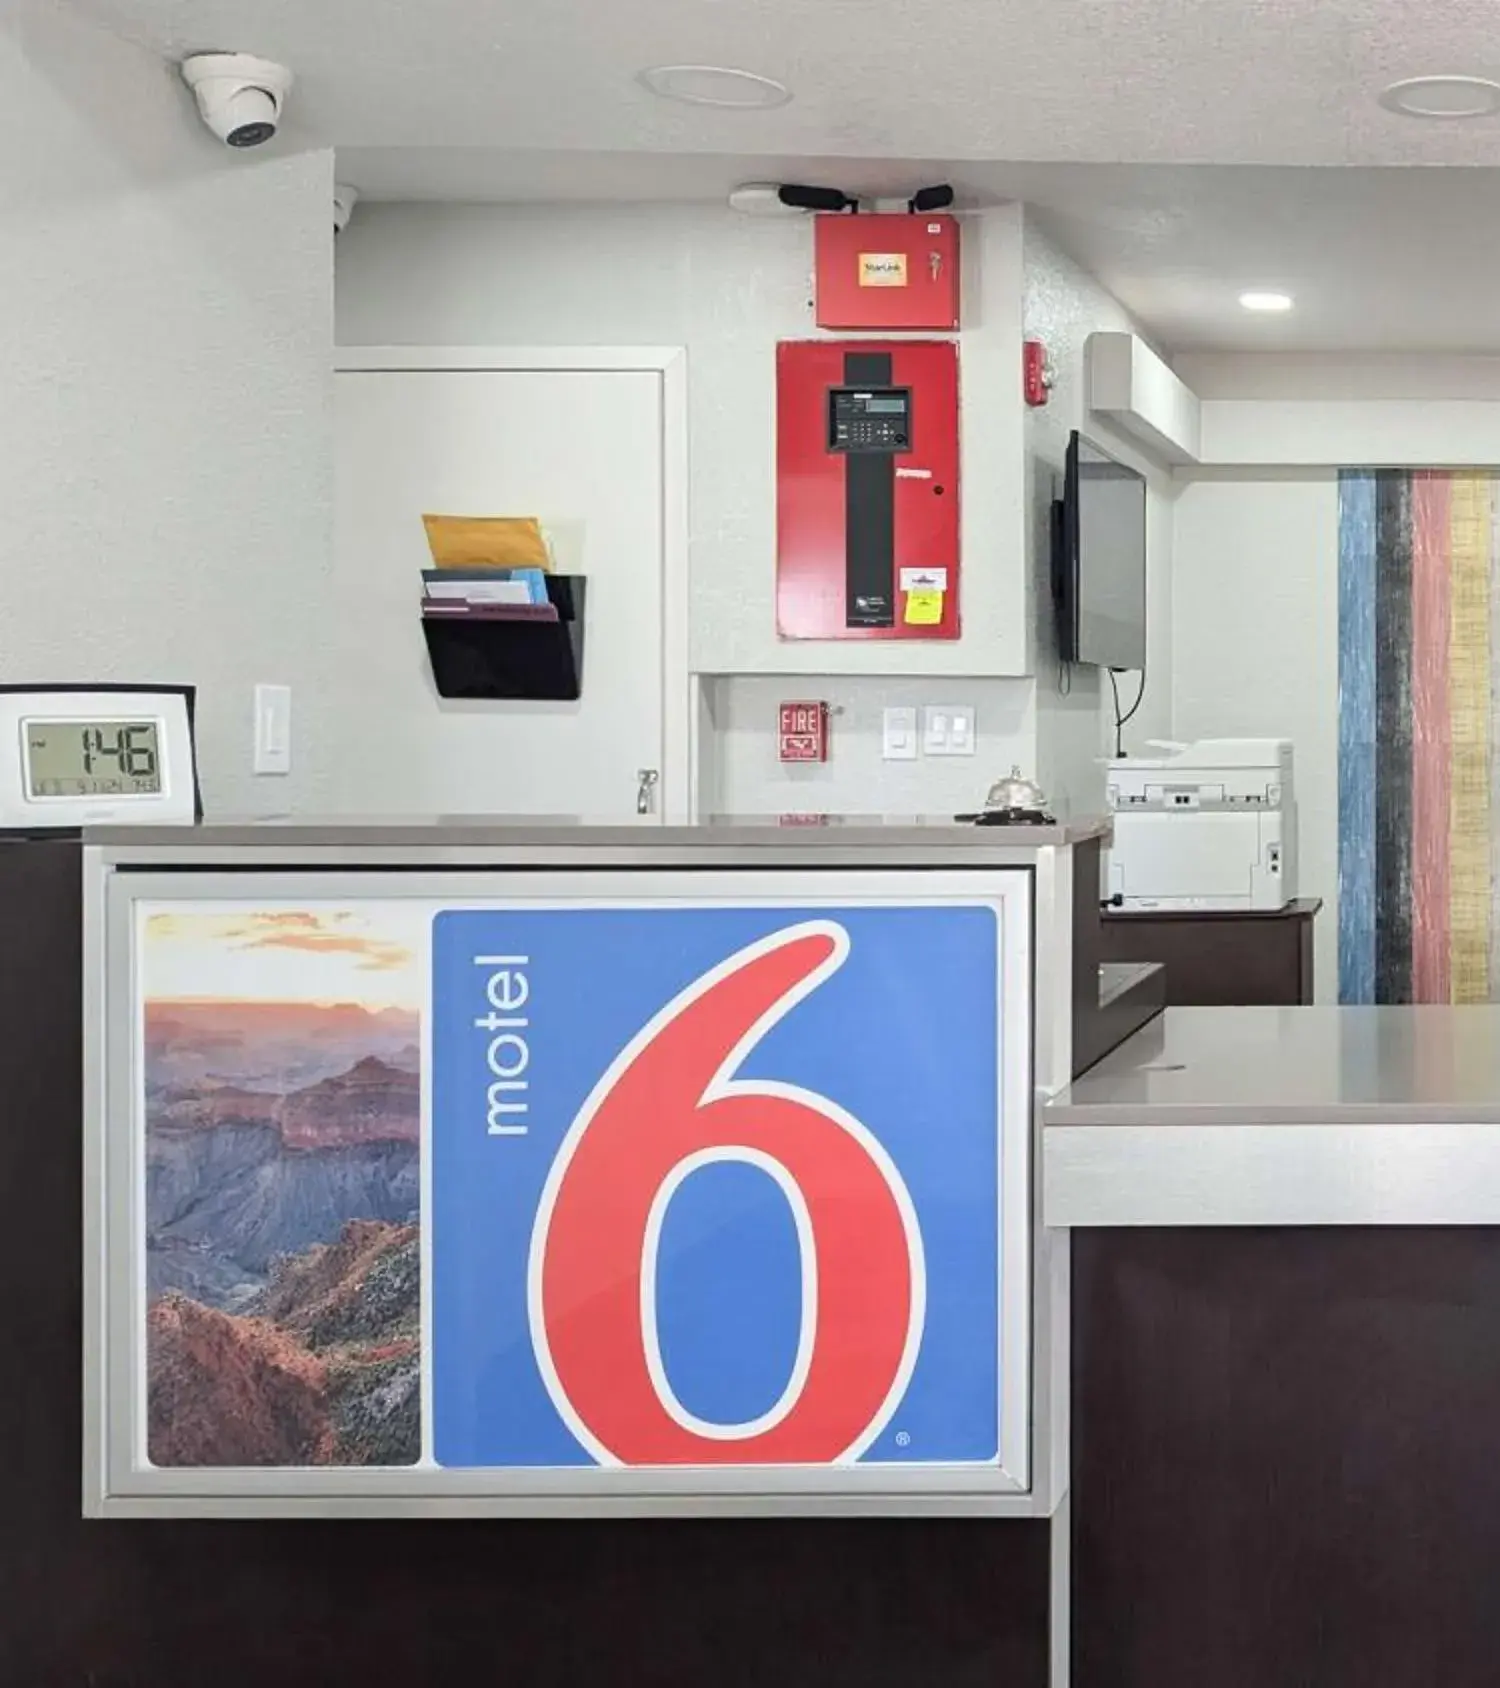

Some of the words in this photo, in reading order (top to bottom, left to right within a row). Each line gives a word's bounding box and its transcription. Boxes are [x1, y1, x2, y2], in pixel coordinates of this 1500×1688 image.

[781, 708, 818, 732] FIRE
[473, 953, 530, 1136] motel
[527, 919, 927, 1467] 6
